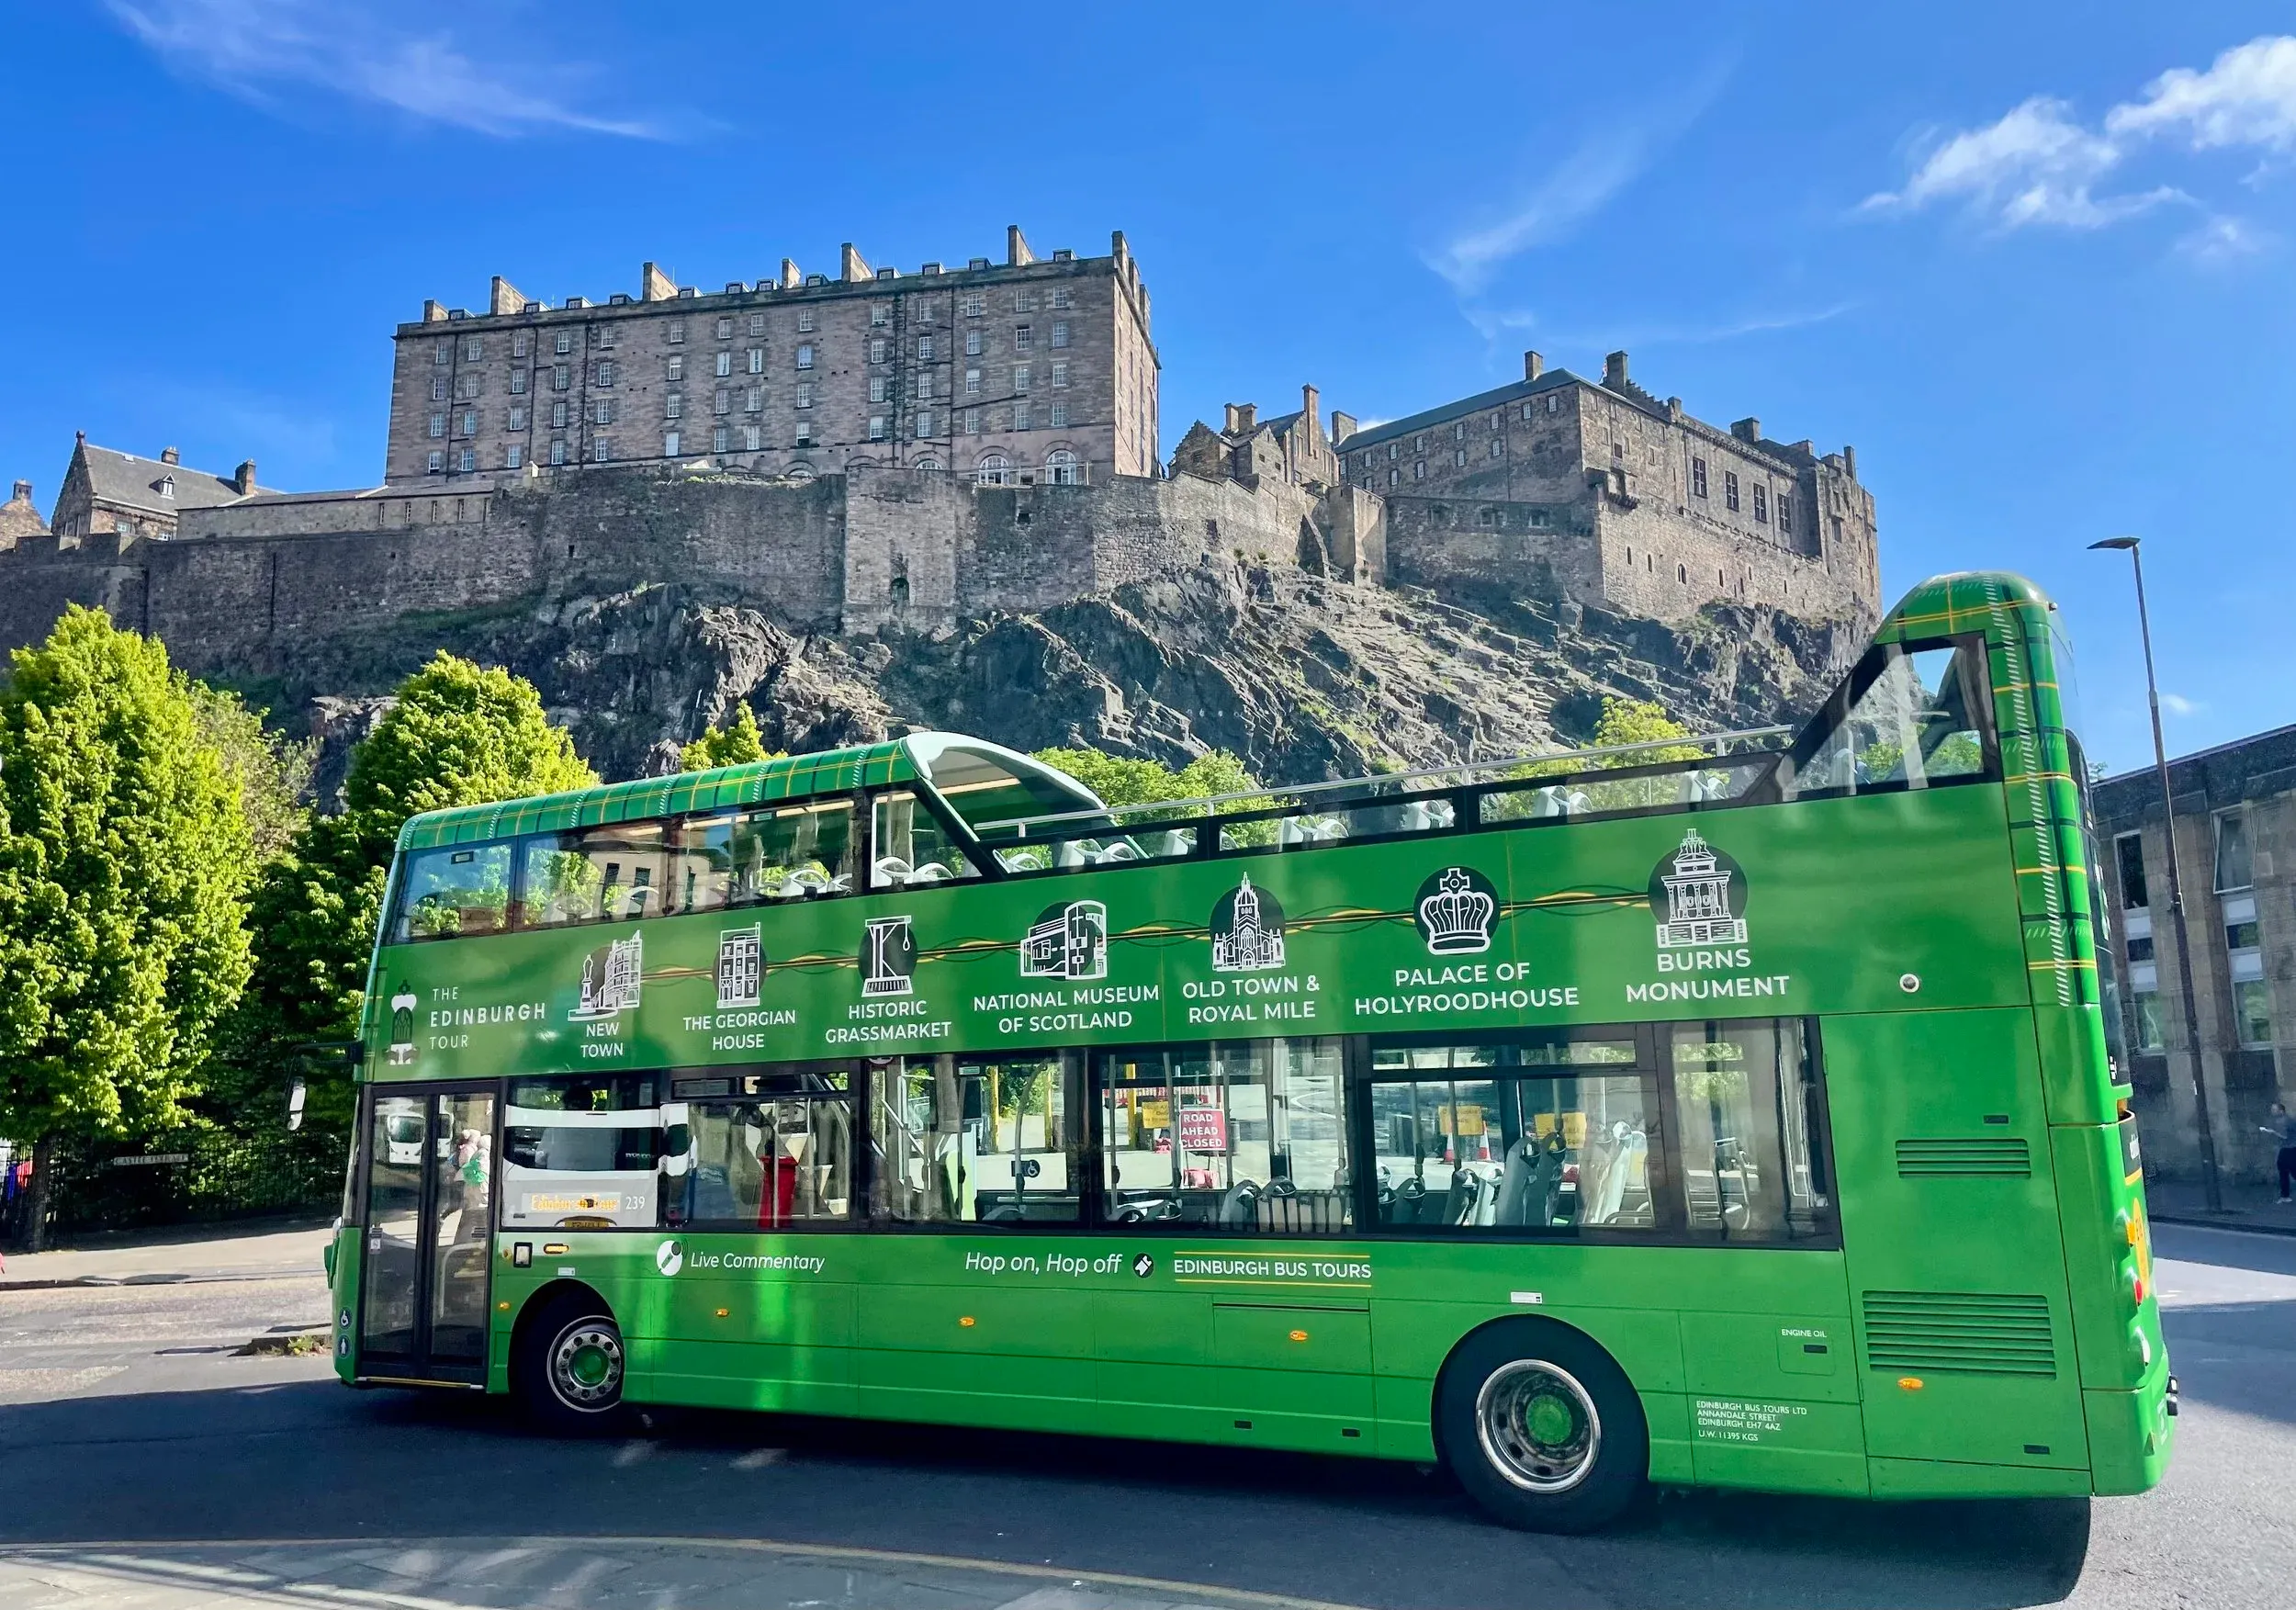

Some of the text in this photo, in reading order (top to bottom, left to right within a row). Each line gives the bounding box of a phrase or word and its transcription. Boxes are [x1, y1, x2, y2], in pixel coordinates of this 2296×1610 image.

[1657, 948, 1751, 973] BURNS
[1395, 962, 1530, 987] PALACE OF
[433, 986, 459, 1001] THE
[1182, 974, 1321, 999] OLD TOWN &
[1626, 975, 1790, 1003] MONUMENT
[974, 985, 1160, 1012] NATIONAL MUSEUM
[1355, 986, 1580, 1016] HOLYROODHOUSE
[430, 1002, 546, 1028] EDINBURGH
[848, 1000, 928, 1020] HISTORIC
[1188, 1000, 1316, 1024] ROYAL MILE
[586, 1021, 620, 1038] NEW
[682, 1009, 796, 1031] THE GEORGIAN
[998, 1010, 1133, 1034] OF SCOTLAND
[429, 1034, 469, 1050] TOUR
[712, 1033, 765, 1051] HOUSE
[825, 1021, 952, 1044] GRASSMARKET
[580, 1041, 625, 1058] TOWN
[1184, 1113, 1213, 1122] ROAD
[1182, 1126, 1219, 1135] AHEAD
[1181, 1138, 1223, 1148] CLOSED
[625, 1196, 646, 1210] 239
[691, 1252, 826, 1274] Live Commentary
[965, 1252, 1122, 1275] Hop on, Hop off
[1174, 1259, 1372, 1278] EDINBURGH BUS TOURS
[1782, 1328, 1828, 1338] ENGINE OIL
[1696, 1401, 1807, 1415] EDINBURGH BUS TOURS LTD
[1697, 1409, 1777, 1422] ANNANDALE STREET
[1697, 1417, 1782, 1431] EDINBURGH EH7 4AZ
[1698, 1429, 1760, 1442] U.W. 11395 KGS
